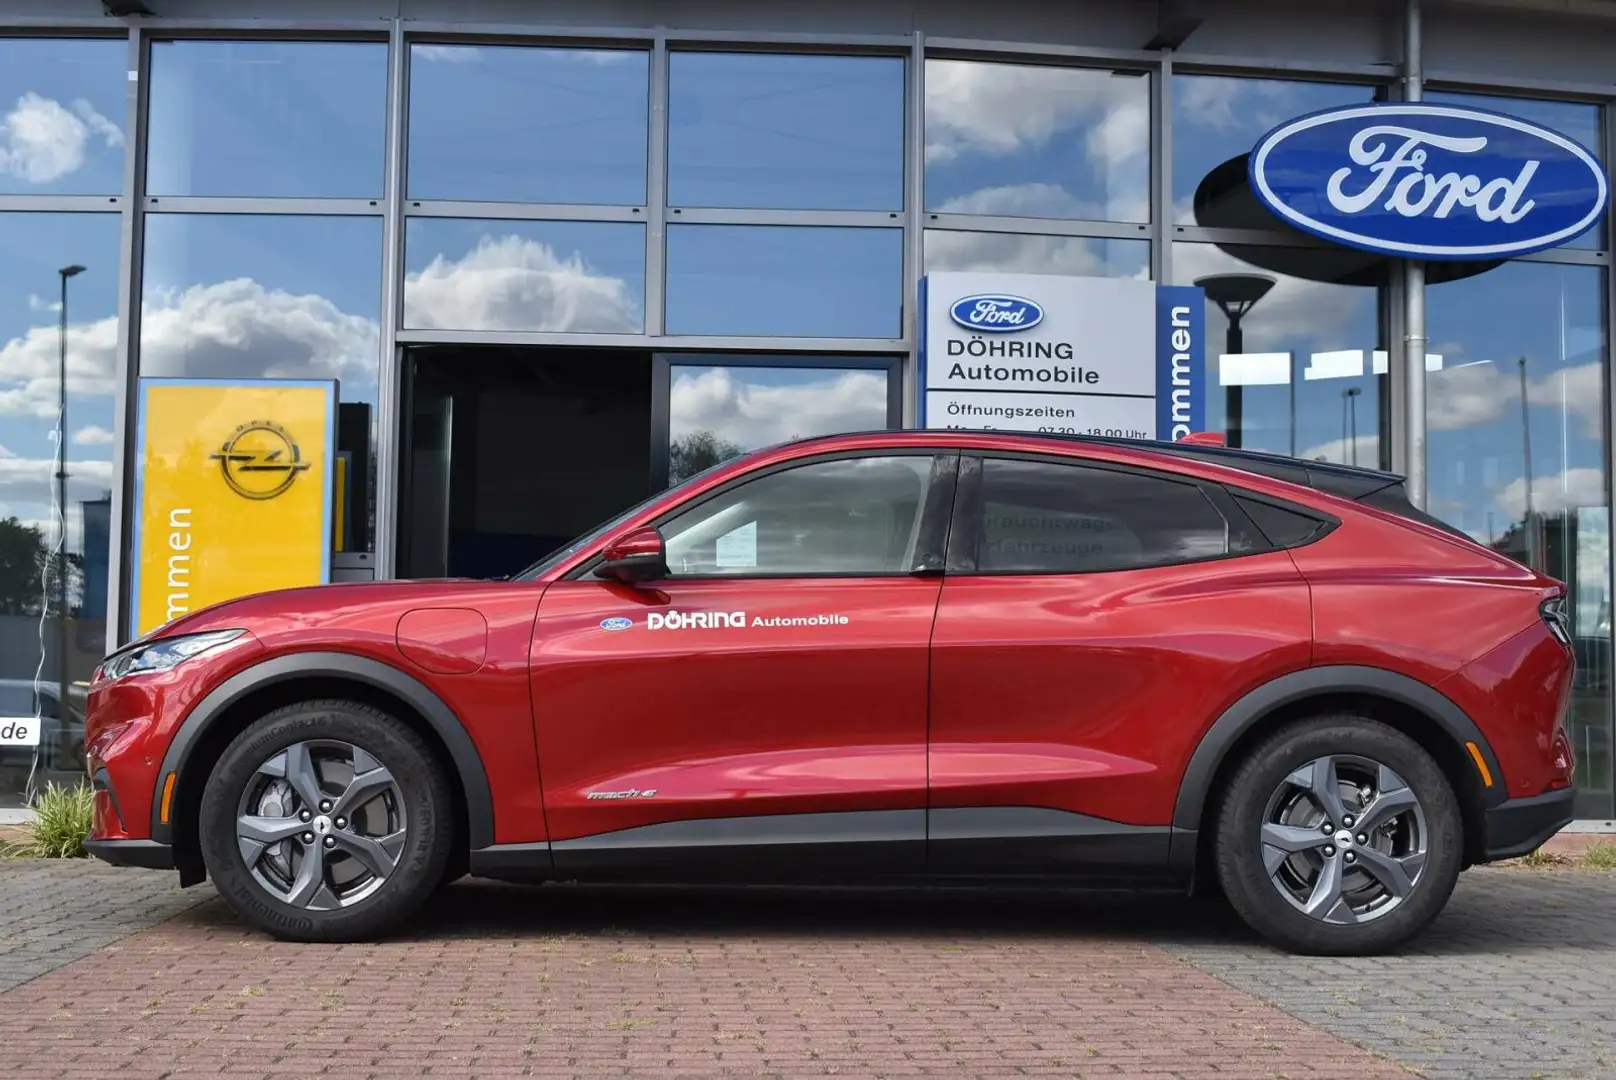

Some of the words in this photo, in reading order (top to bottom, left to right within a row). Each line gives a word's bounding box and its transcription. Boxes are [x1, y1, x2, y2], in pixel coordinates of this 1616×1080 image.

[1327, 125, 1540, 224] Ford
[969, 299, 1026, 324] Ford
[947, 336, 1074, 360] DÖHRING
[948, 363, 1100, 385] Automobile
[947, 401, 1076, 419] Öffnungszeiten
[1038, 426, 1075, 434] 0730
[1086, 428, 1123, 438] 1800
[1126, 430, 1148, 439] Uhr
[751, 614, 849, 628] Automobile
[1, 722, 28, 740] de
